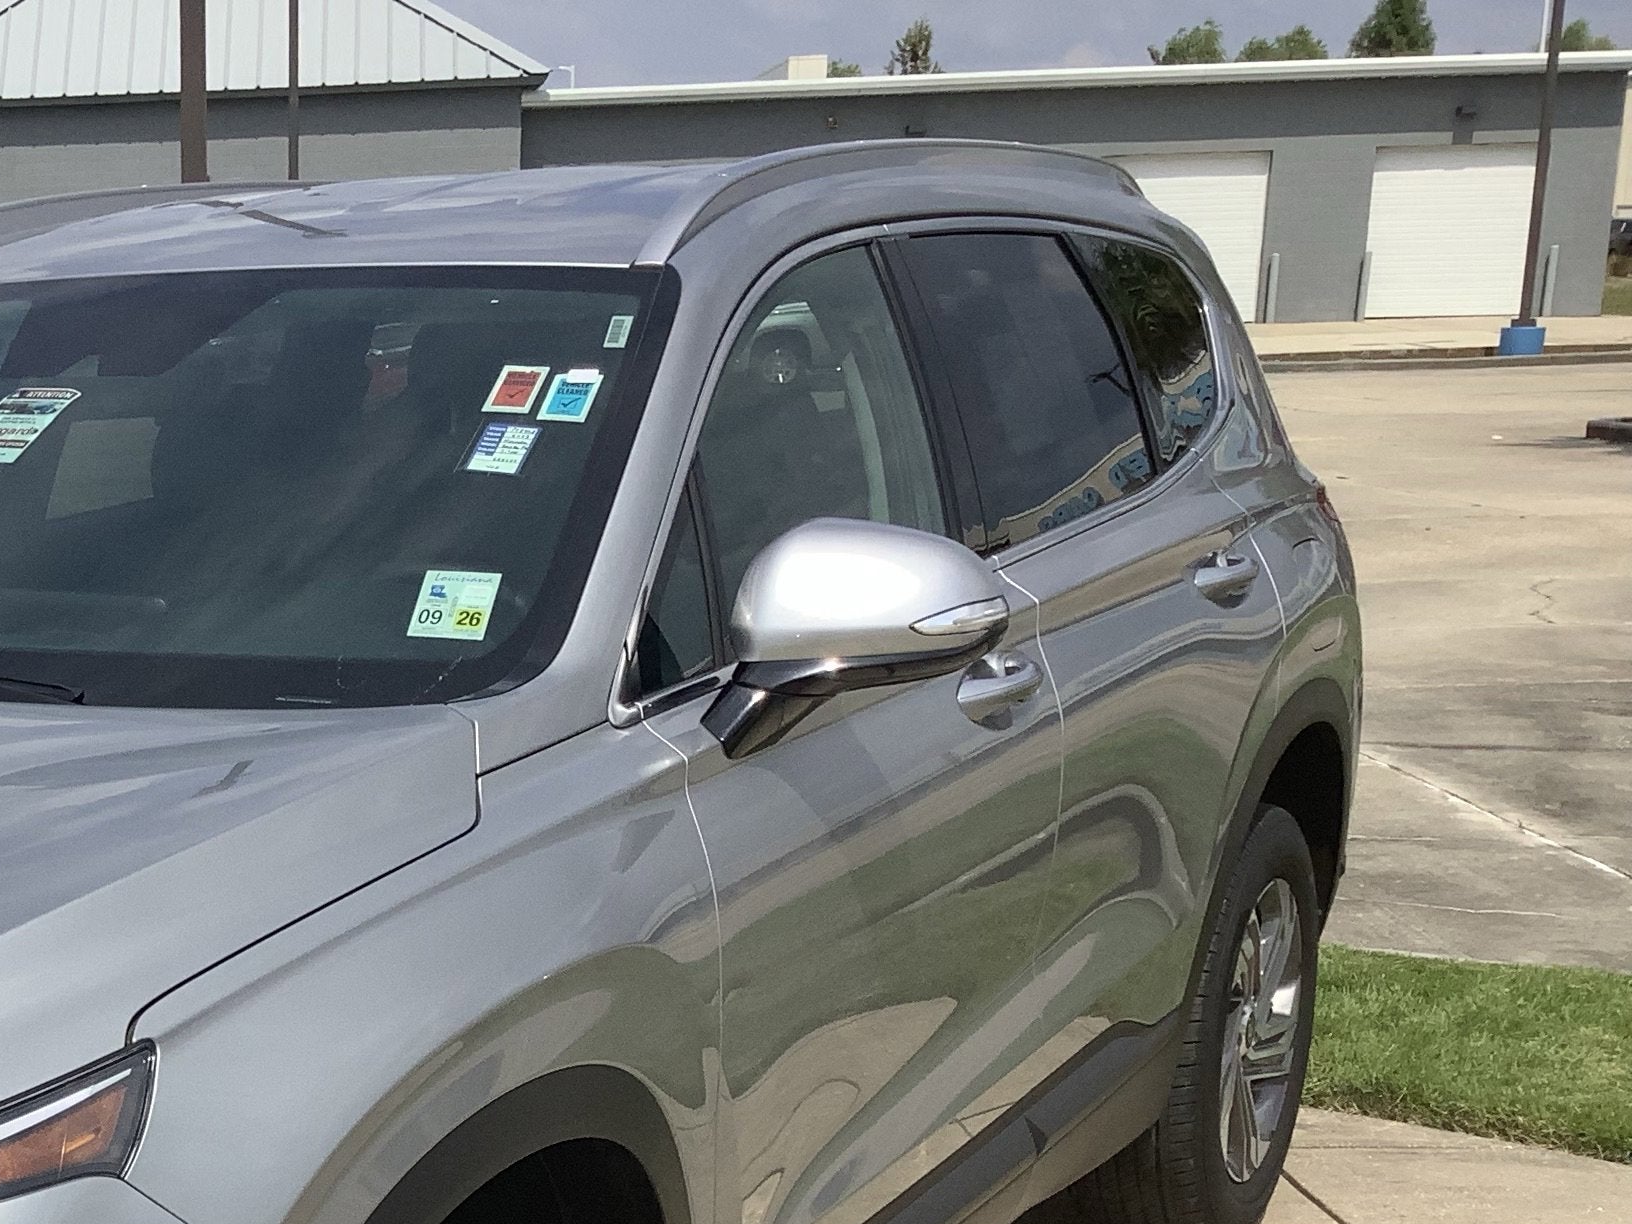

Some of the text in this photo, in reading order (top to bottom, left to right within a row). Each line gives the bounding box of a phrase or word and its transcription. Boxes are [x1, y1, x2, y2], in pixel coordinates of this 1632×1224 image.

[25, 391, 75, 399] ATTENTION
[556, 387, 588, 396] CLEANED
[435, 572, 494, 583] Louisiana
[418, 609, 482, 626] 09 26
